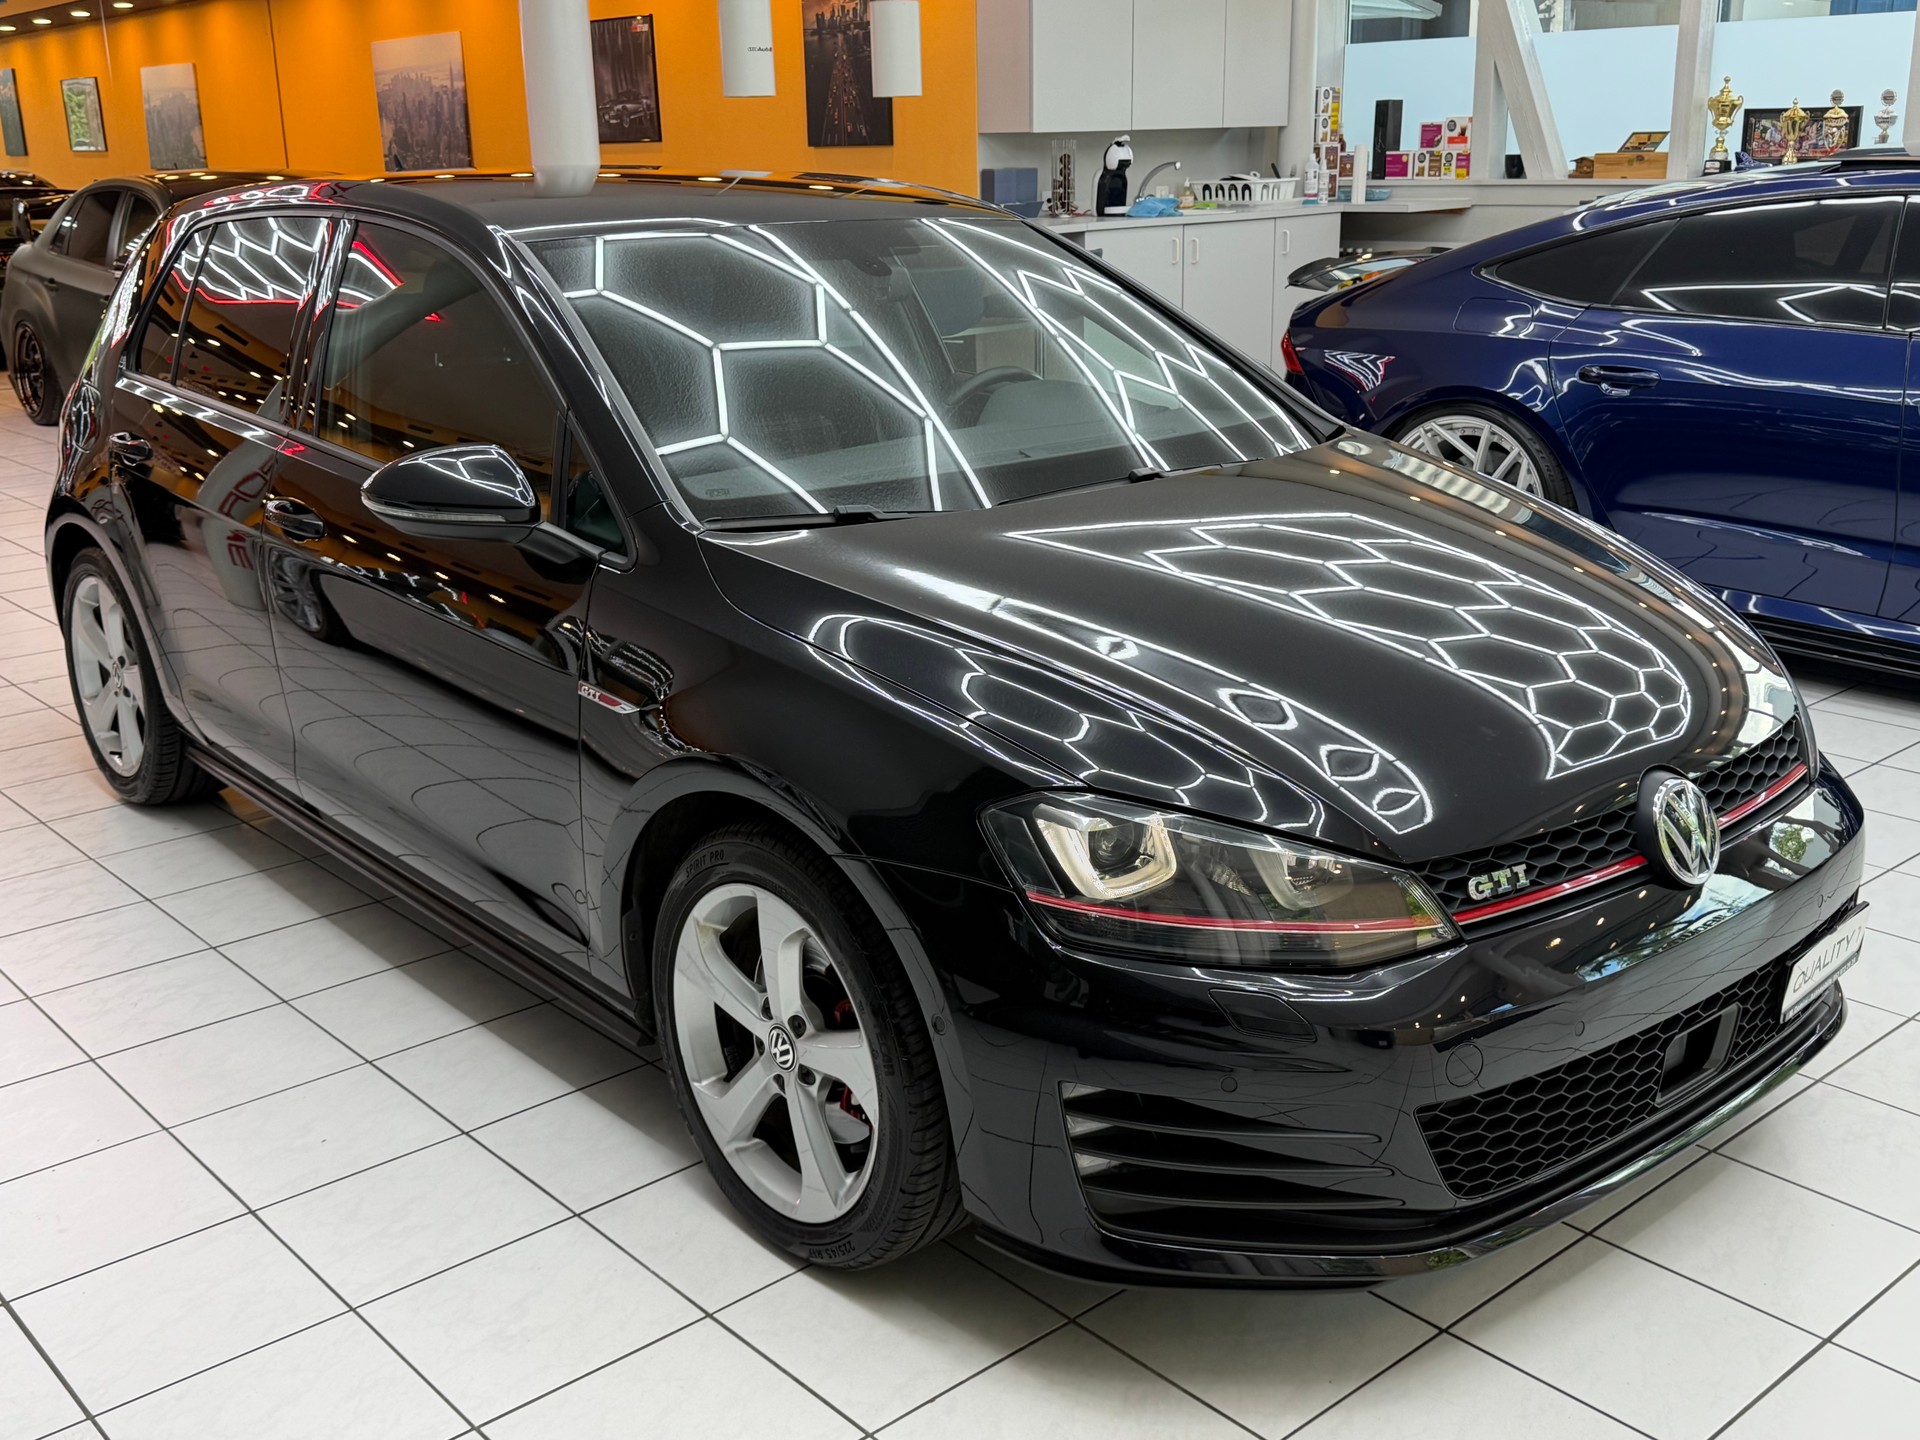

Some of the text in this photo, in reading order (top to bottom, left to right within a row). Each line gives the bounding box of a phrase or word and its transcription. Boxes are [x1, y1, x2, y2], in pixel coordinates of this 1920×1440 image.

[580, 686, 601, 702] GTI
[685, 848, 725, 879] SPIRIT PRO
[1467, 862, 1531, 902] GTI
[1793, 929, 1856, 994] QUALITY
